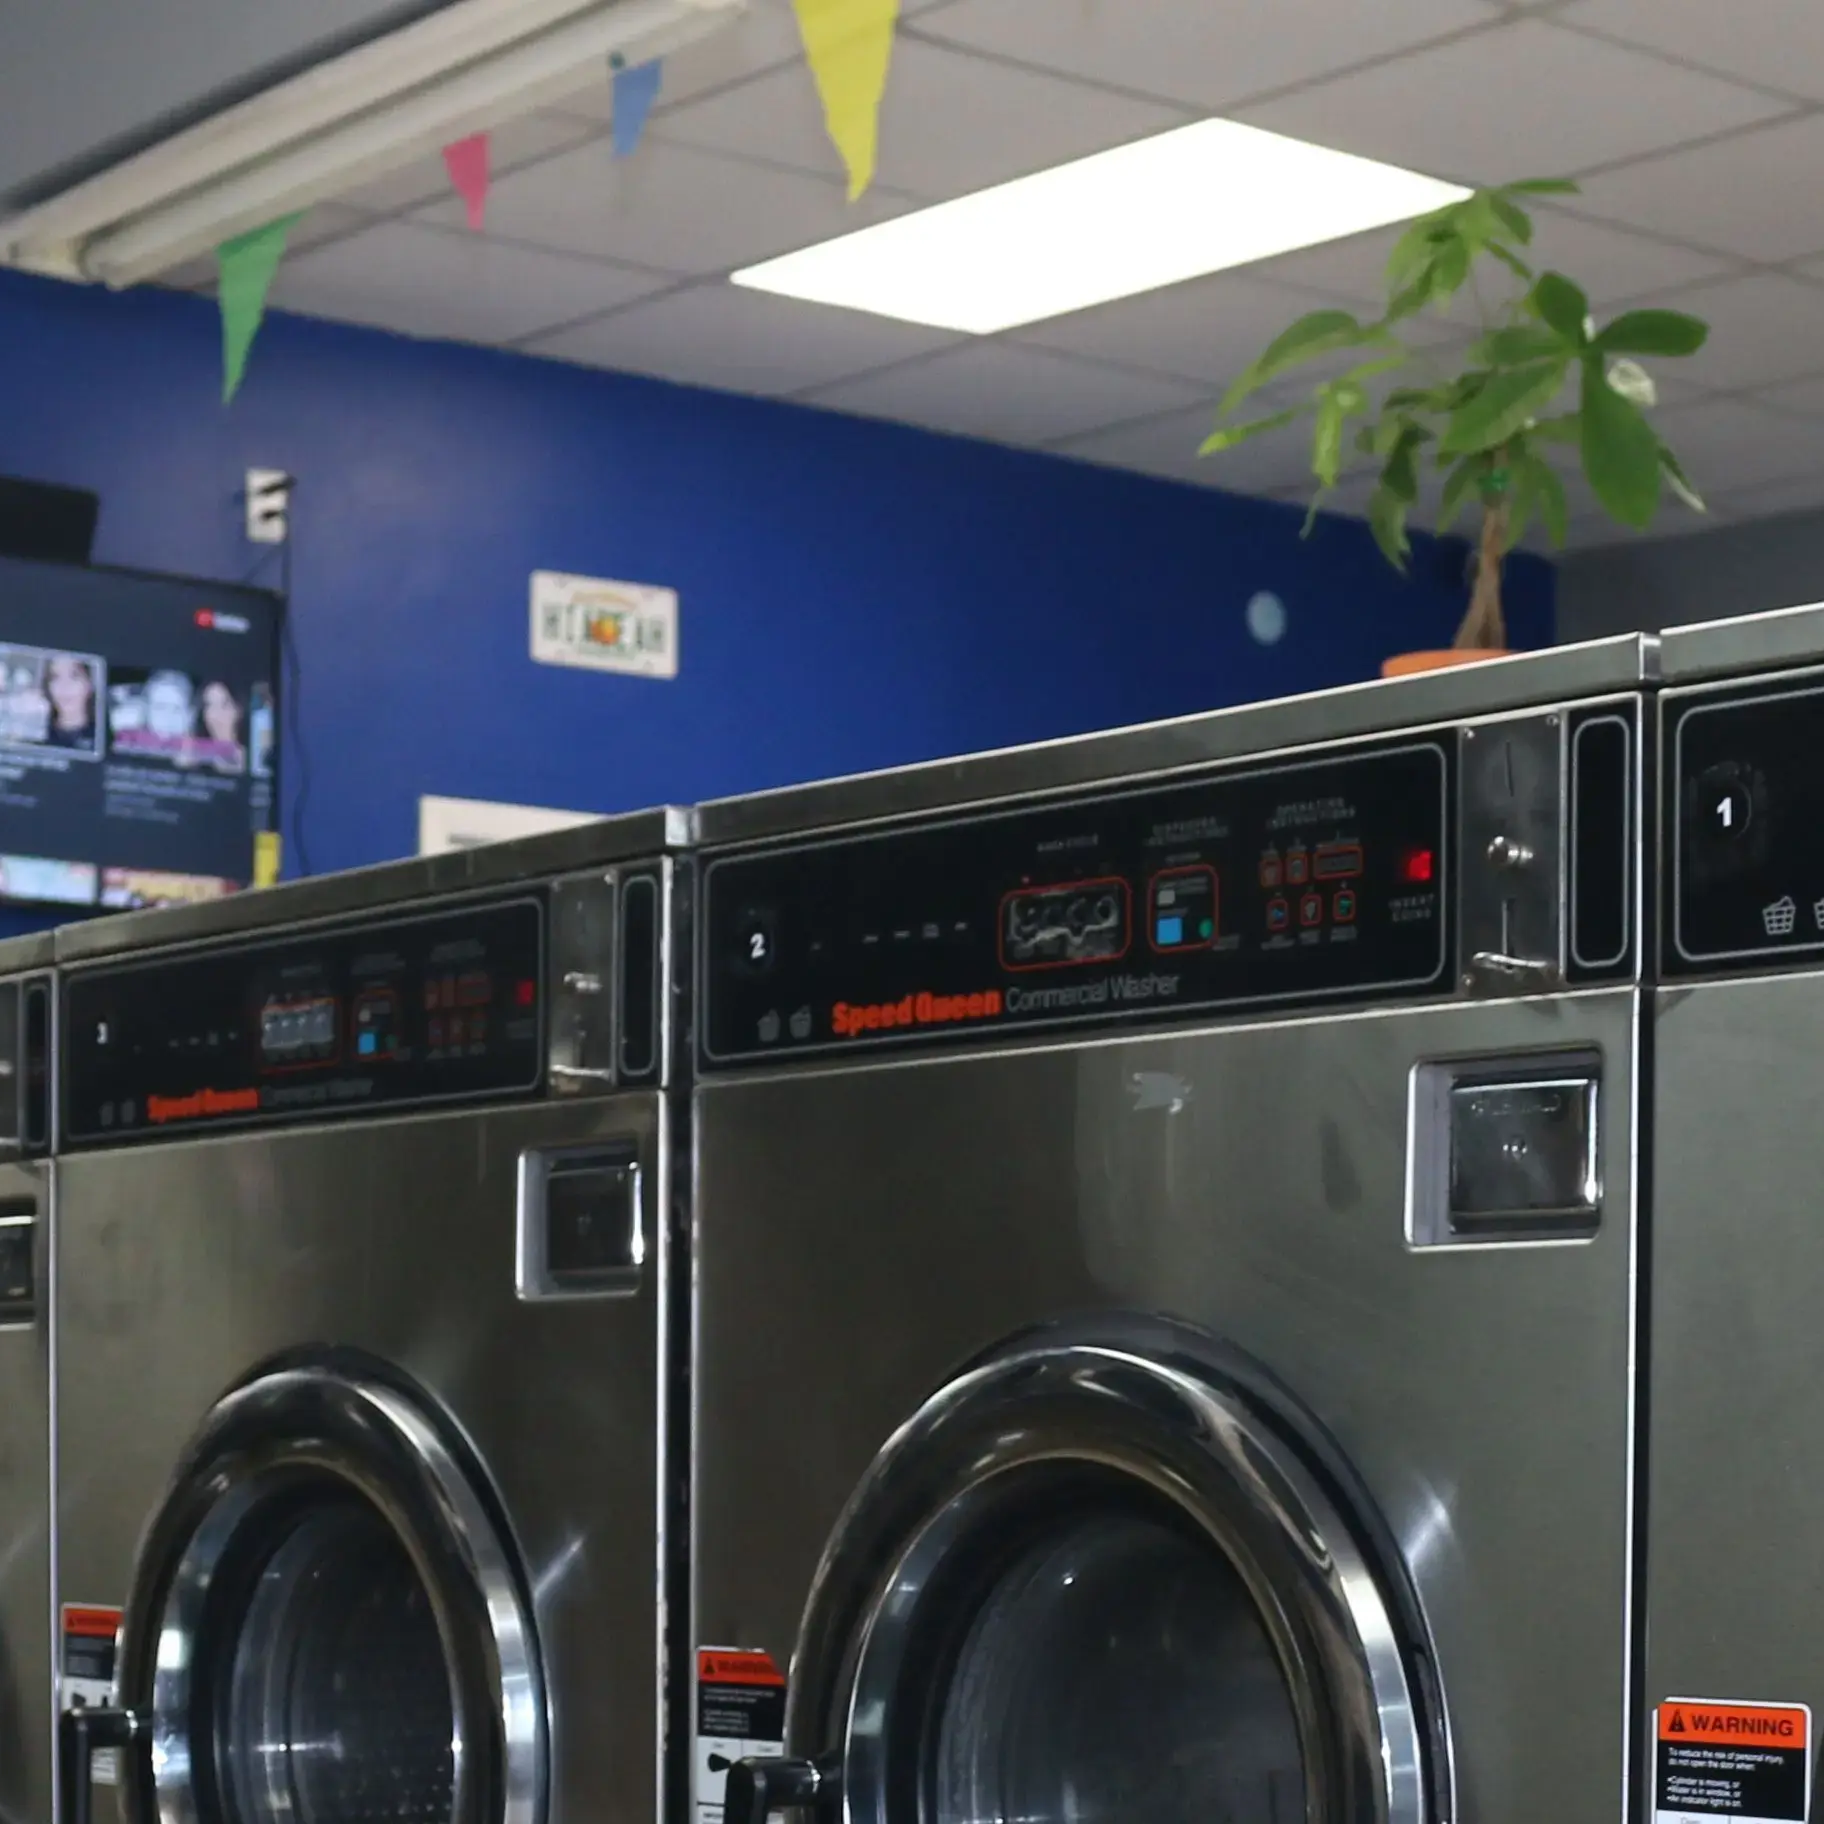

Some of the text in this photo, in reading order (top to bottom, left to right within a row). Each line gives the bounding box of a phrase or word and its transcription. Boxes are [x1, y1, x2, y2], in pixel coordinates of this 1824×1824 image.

[1716, 796, 1732, 828] 1
[750, 932, 766, 960] 2
[831, 973, 1180, 1037] Speed Queen Commercial Washer
[1691, 1715, 1794, 1737] WARNING
